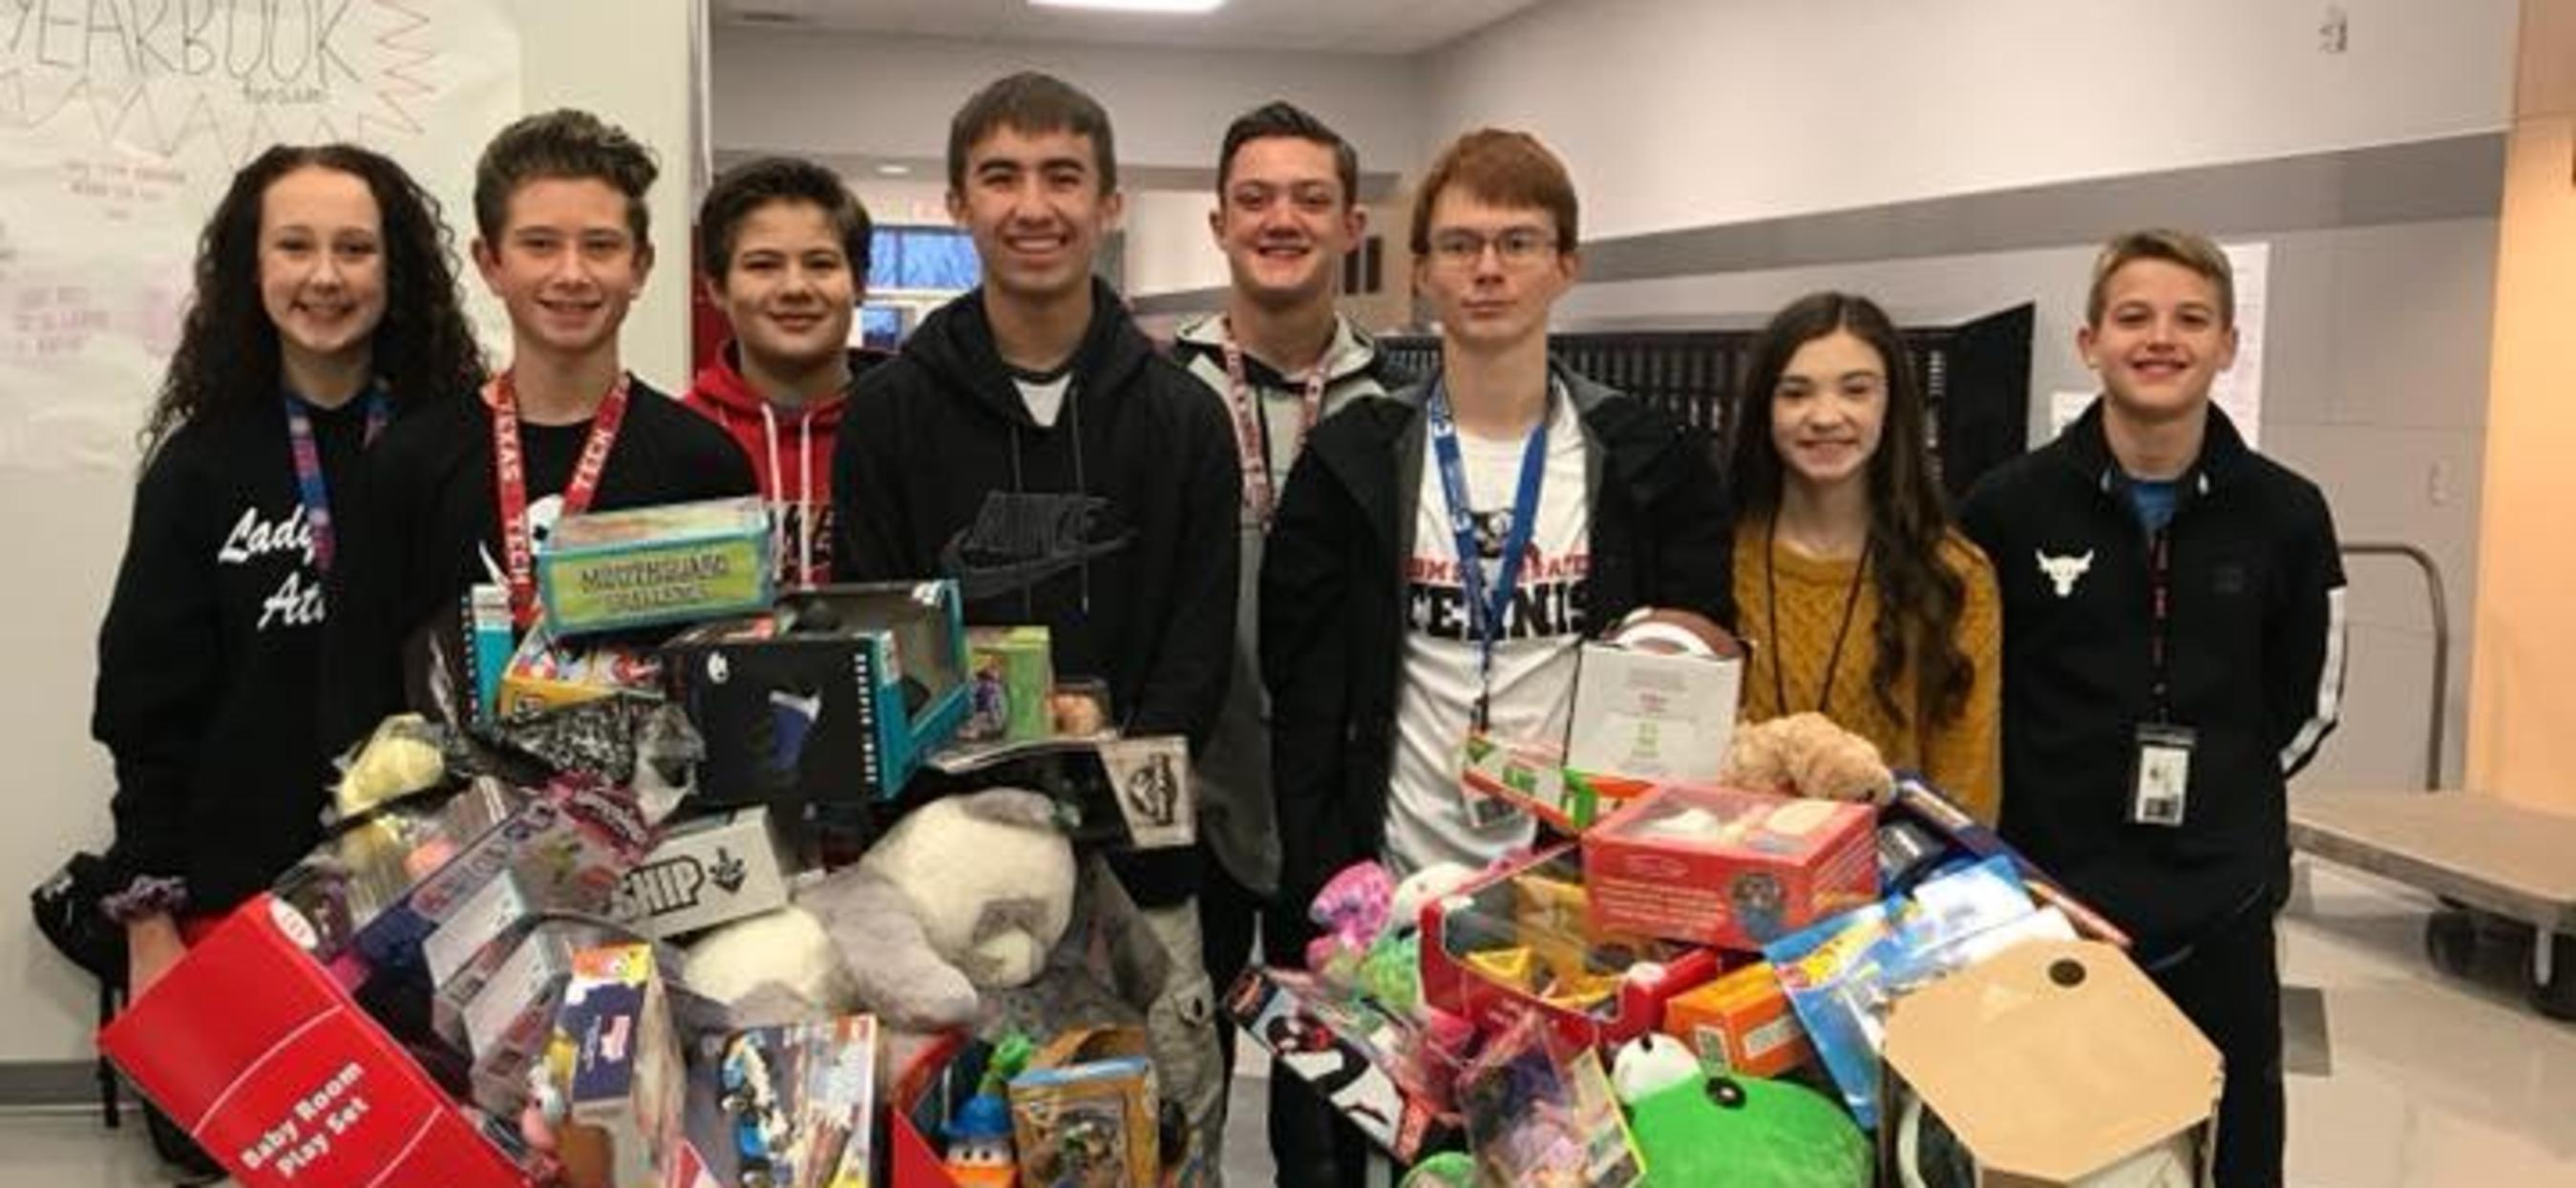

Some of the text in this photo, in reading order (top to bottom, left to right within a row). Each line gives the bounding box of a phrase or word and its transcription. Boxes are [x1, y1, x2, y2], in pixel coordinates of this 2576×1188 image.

[218, 503, 316, 565] Lady
[241, 1061, 366, 1170] Baby Room
[276, 1097, 370, 1179] Play Set
